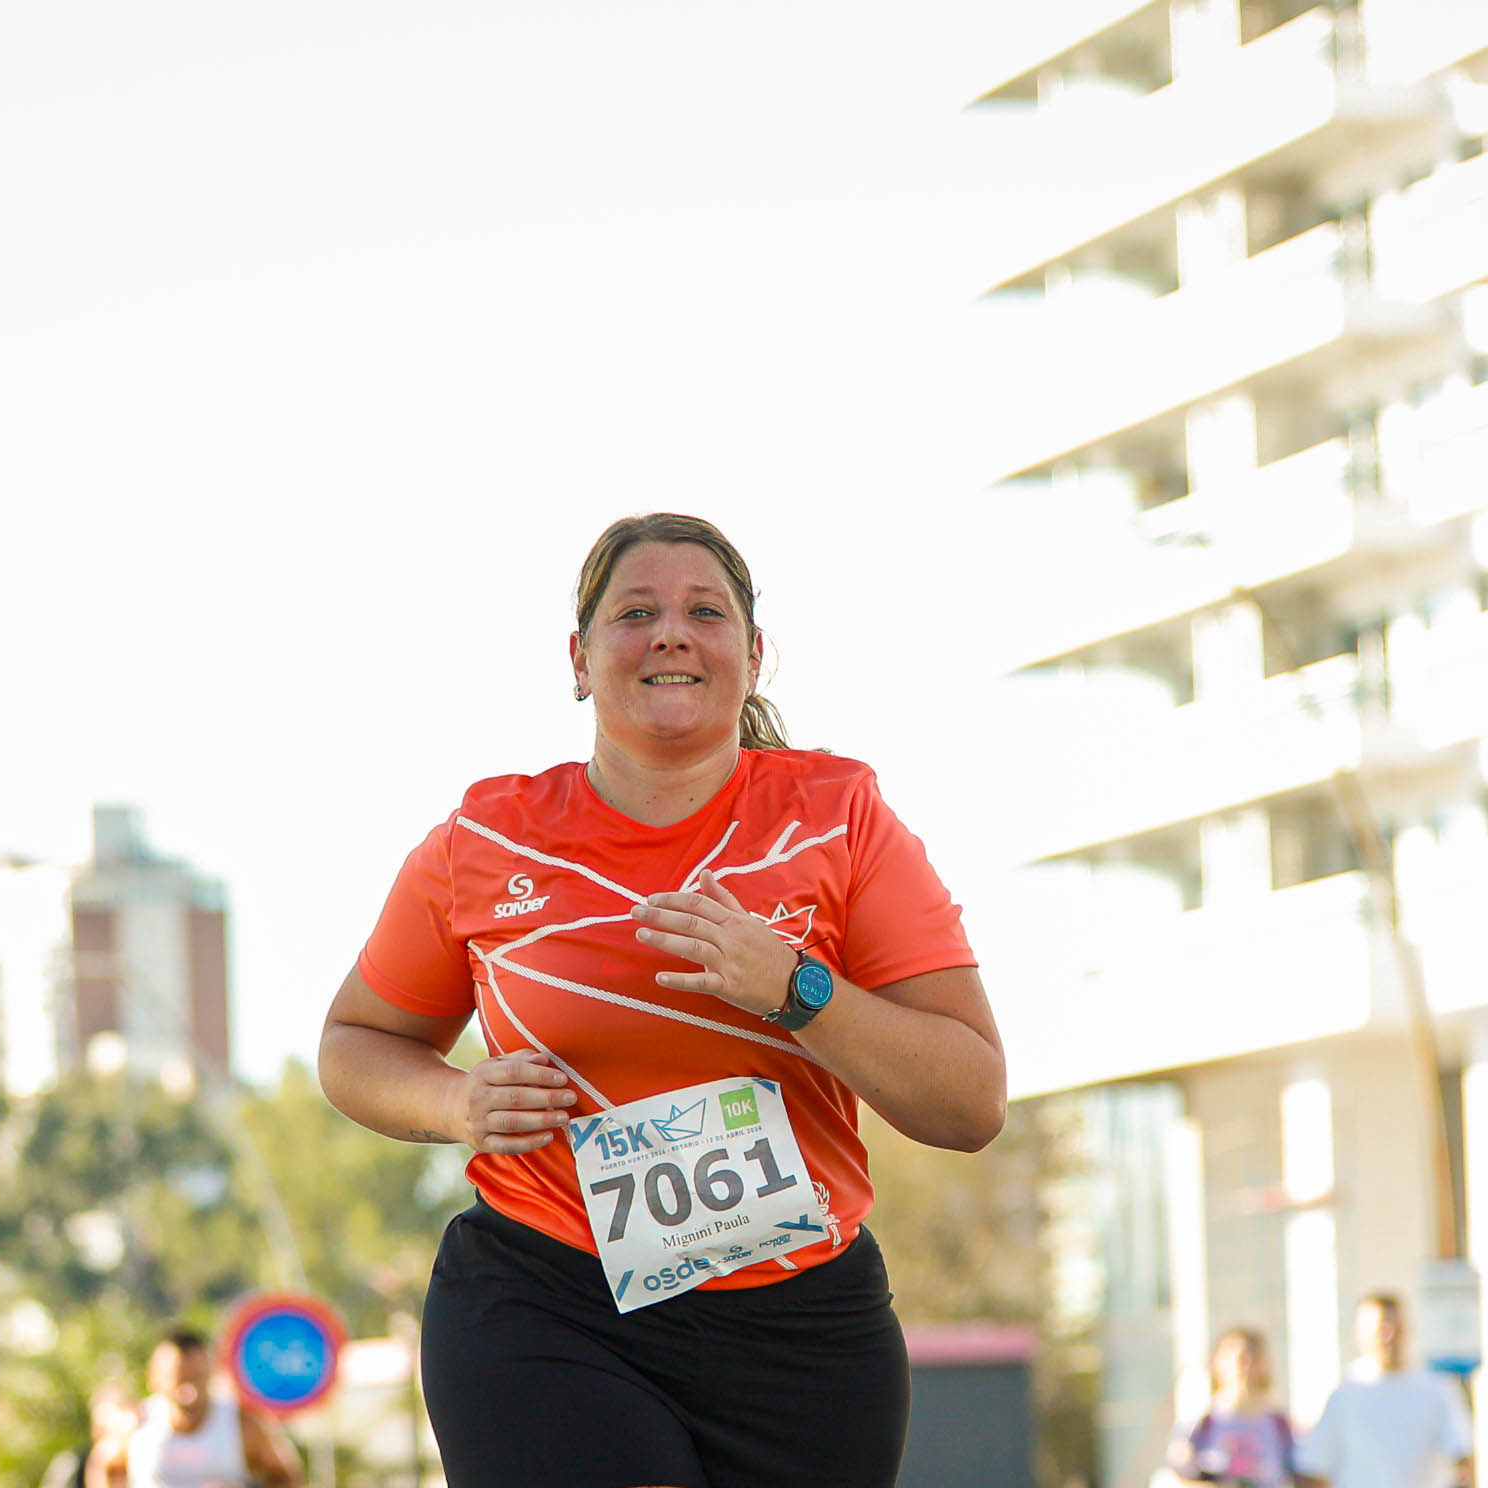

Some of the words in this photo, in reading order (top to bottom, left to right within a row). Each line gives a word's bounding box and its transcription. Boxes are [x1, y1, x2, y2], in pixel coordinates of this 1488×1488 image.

[724, 1098, 754, 1118] 10K
[595, 1121, 654, 1160] 15K
[589, 1137, 798, 1243] 7061
[662, 1223, 713, 1249] Mignini
[714, 1213, 751, 1234] Paula
[643, 1256, 711, 1291] osde
